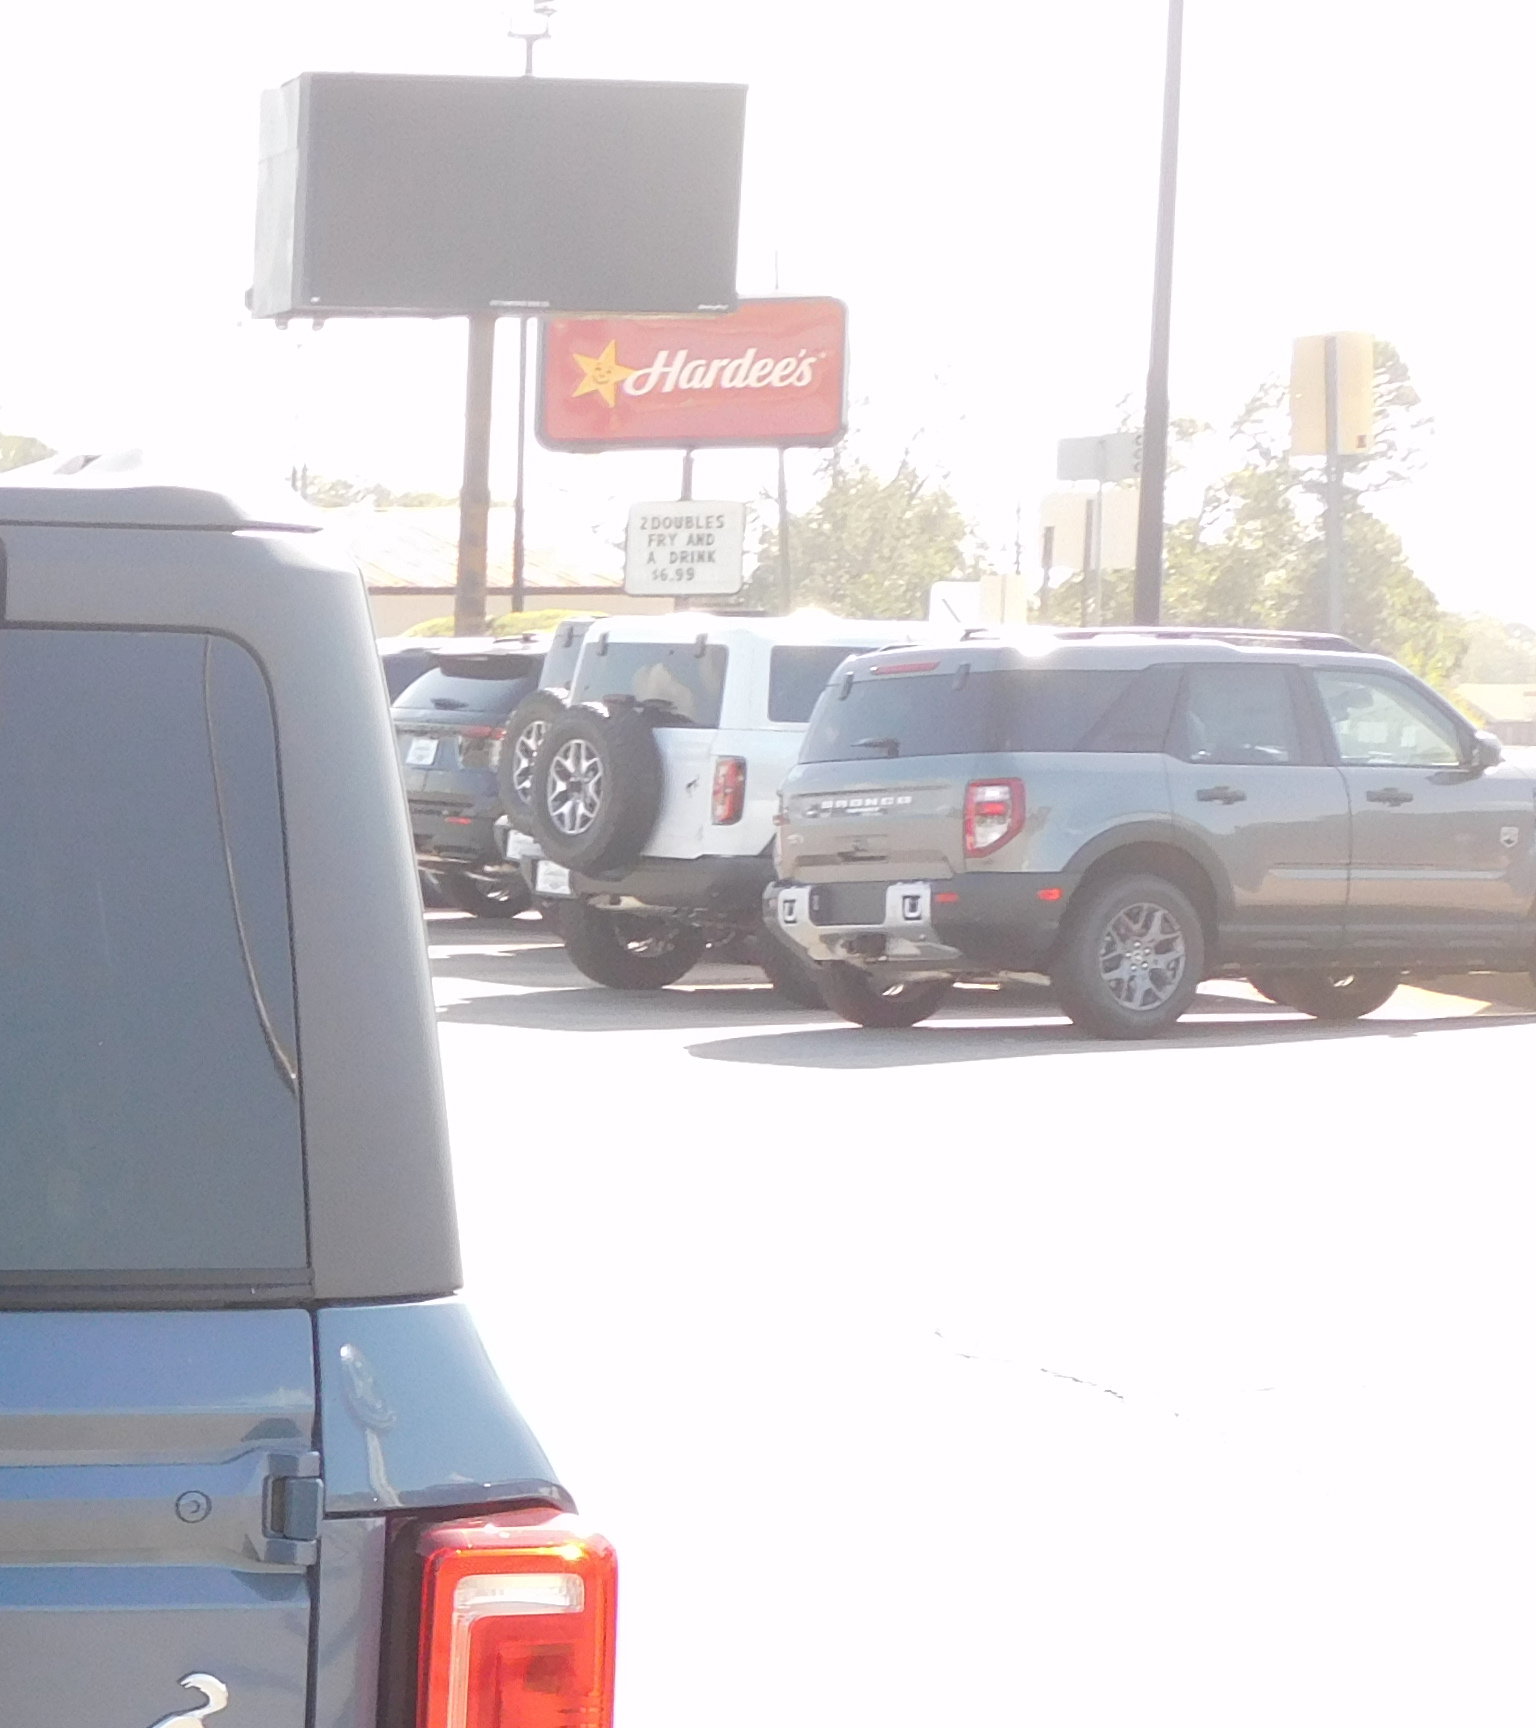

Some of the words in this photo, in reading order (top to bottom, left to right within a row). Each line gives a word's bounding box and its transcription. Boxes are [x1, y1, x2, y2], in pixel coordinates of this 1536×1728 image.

[622, 347, 819, 396] Hardee's
[648, 533, 678, 547] FRY
[686, 533, 716, 546] AND
[646, 551, 657, 564] A
[669, 550, 717, 564] DRINK
[652, 567, 695, 581] $6.99
